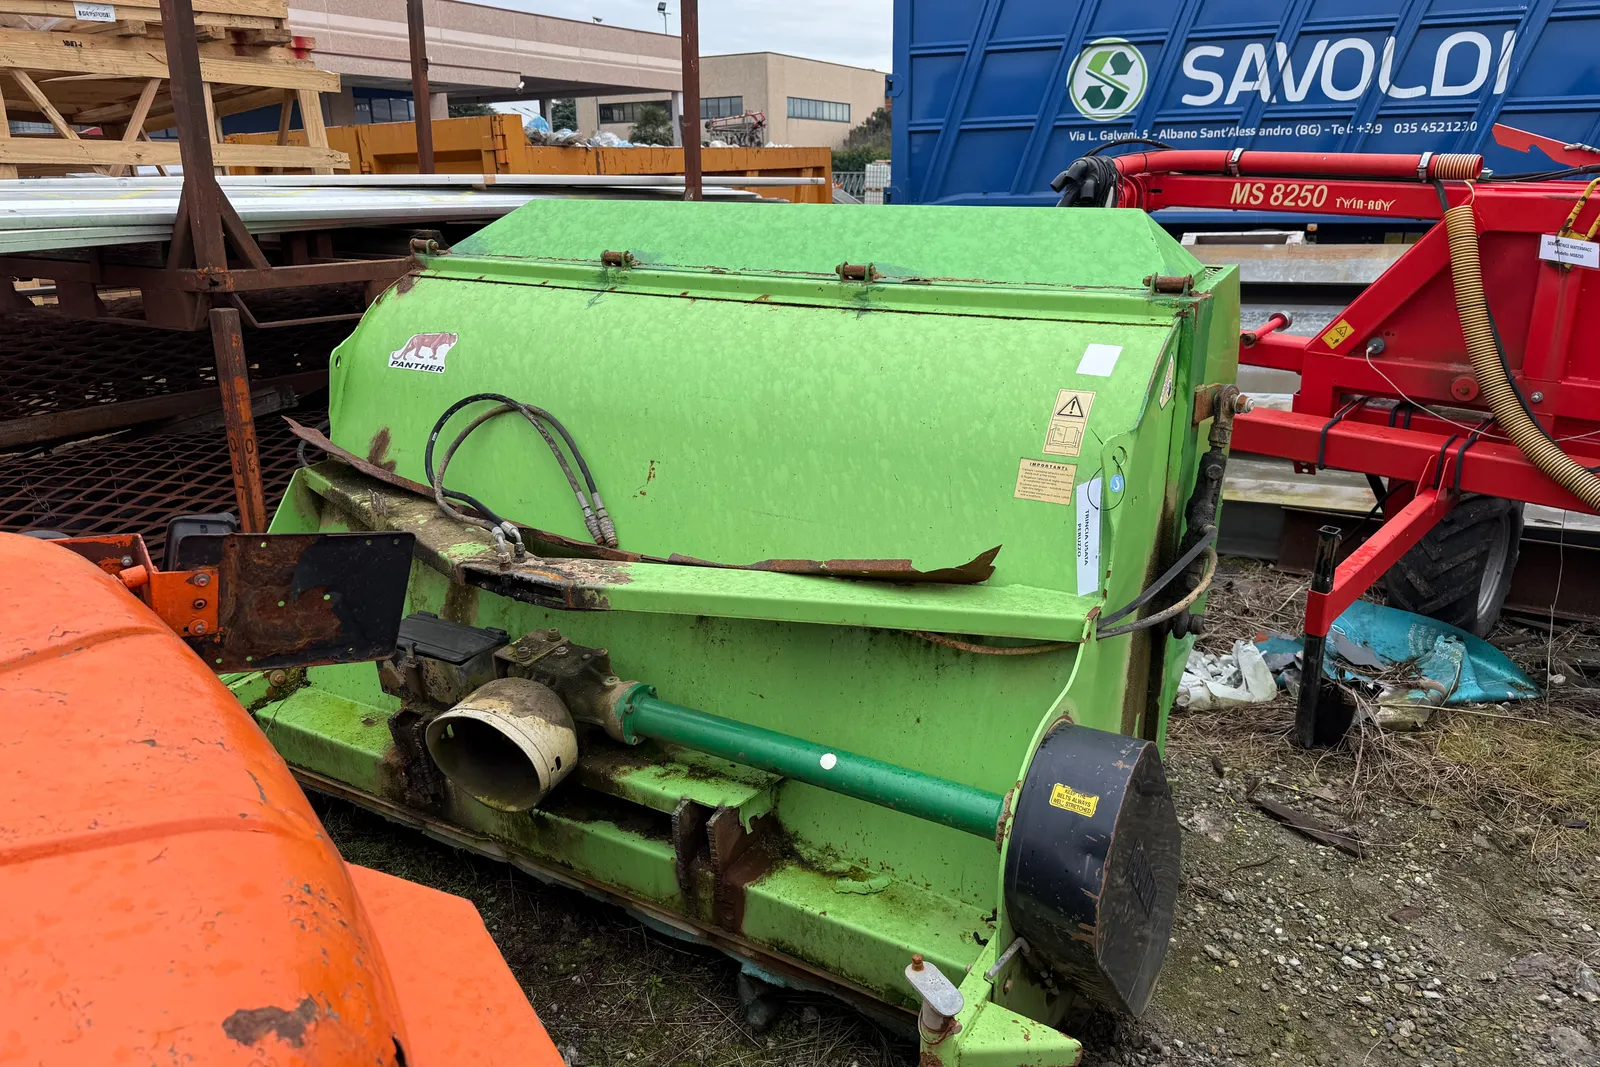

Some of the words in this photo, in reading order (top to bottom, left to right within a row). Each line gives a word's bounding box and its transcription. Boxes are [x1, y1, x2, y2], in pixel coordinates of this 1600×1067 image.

[1181, 30, 1516, 106] SAVOLDI
[1069, 131, 1086, 142] Via
[1088, 131, 1097, 140] L.
[1159, 128, 1197, 139] Albano
[1295, 124, 1321, 137] (BG)
[1394, 122, 1418, 134] 035
[1420, 121, 1478, 133] 4521230
[1230, 182, 1266, 205] MS
[1269, 184, 1328, 208] 8250
[390, 360, 445, 373] PANTHER
[1057, 792, 1071, 801] BELTS
[1072, 797, 1091, 807] ALWAYS
[1065, 801, 1092, 813] STRETCHED
